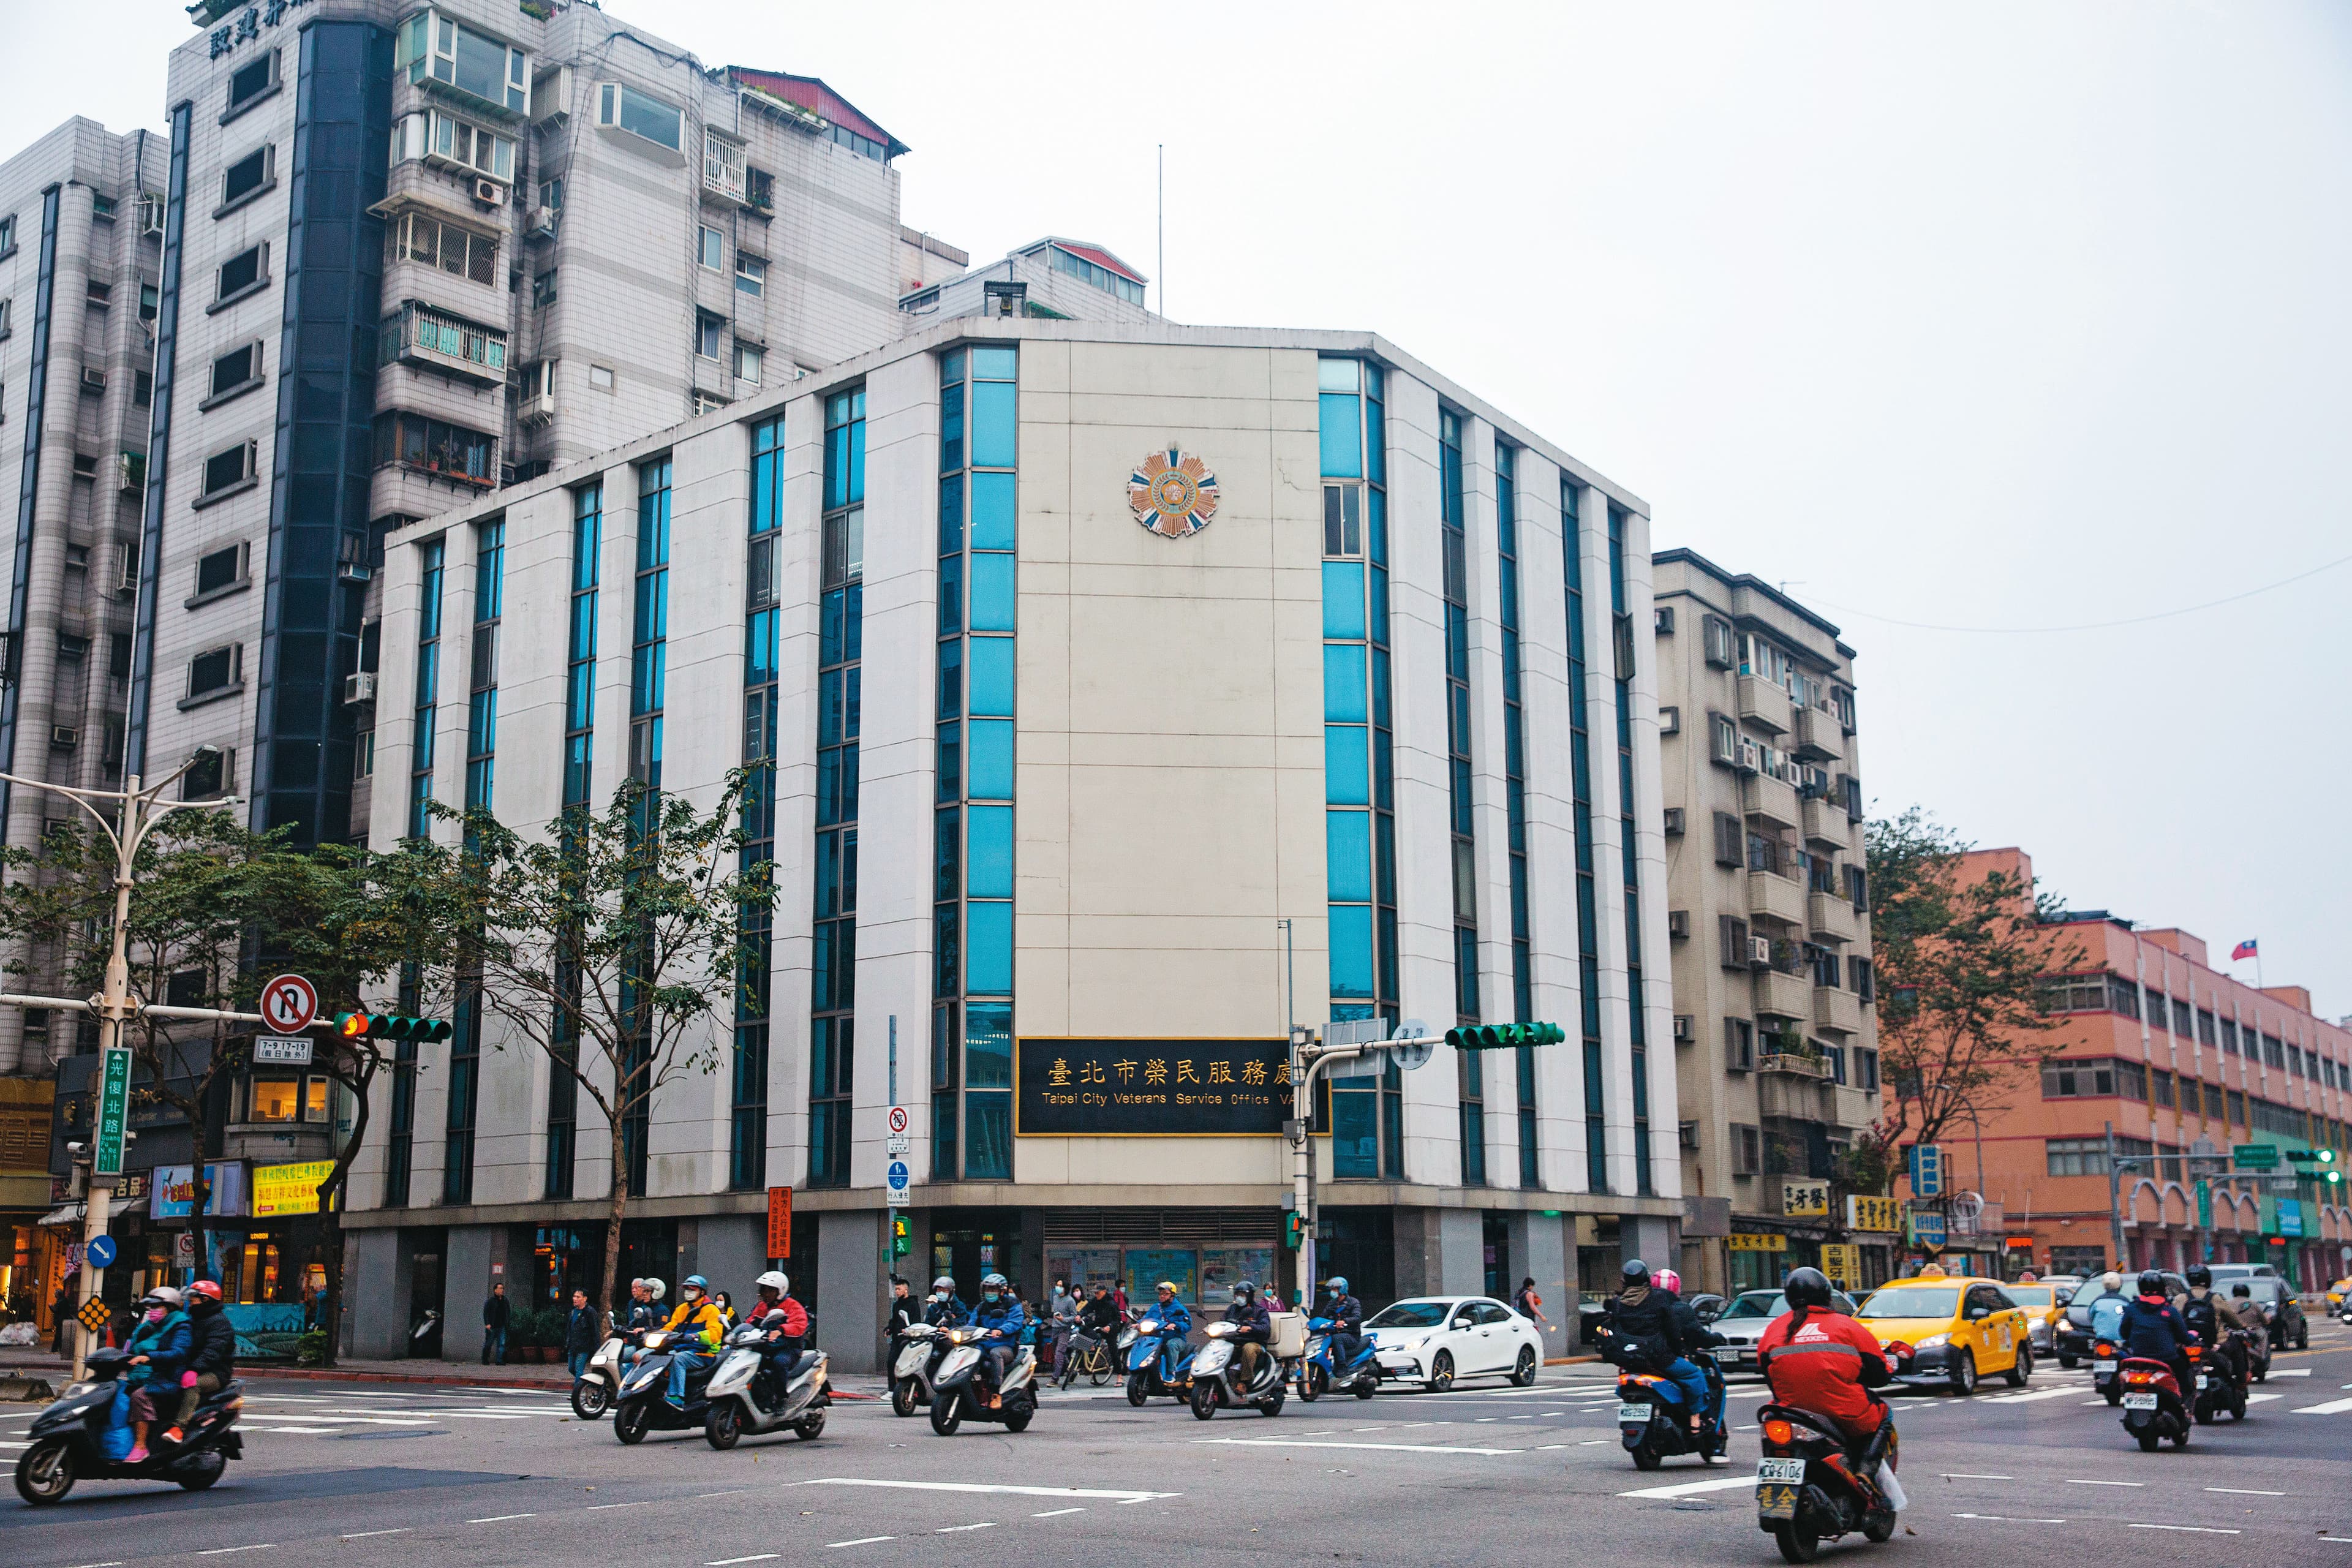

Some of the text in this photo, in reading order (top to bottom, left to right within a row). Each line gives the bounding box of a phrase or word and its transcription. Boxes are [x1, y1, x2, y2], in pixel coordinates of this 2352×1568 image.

[263, 1041, 306, 1051] 7-9 17-19
[262, 1049, 306, 1059] (假日除外)
[1048, 1058, 1291, 1086] 臺北市榮民服務處
[105, 1061, 124, 1133] 光復北路
[1041, 1093, 1078, 1105] Taipei
[1082, 1093, 1107, 1107] City
[1114, 1093, 1166, 1104] Veterans
[1176, 1093, 1223, 1104] Service
[1231, 1093, 1270, 1105] Office
[101, 1134, 121, 1143] Guang
[1828, 1246, 1843, 1277] 吉聖牙
